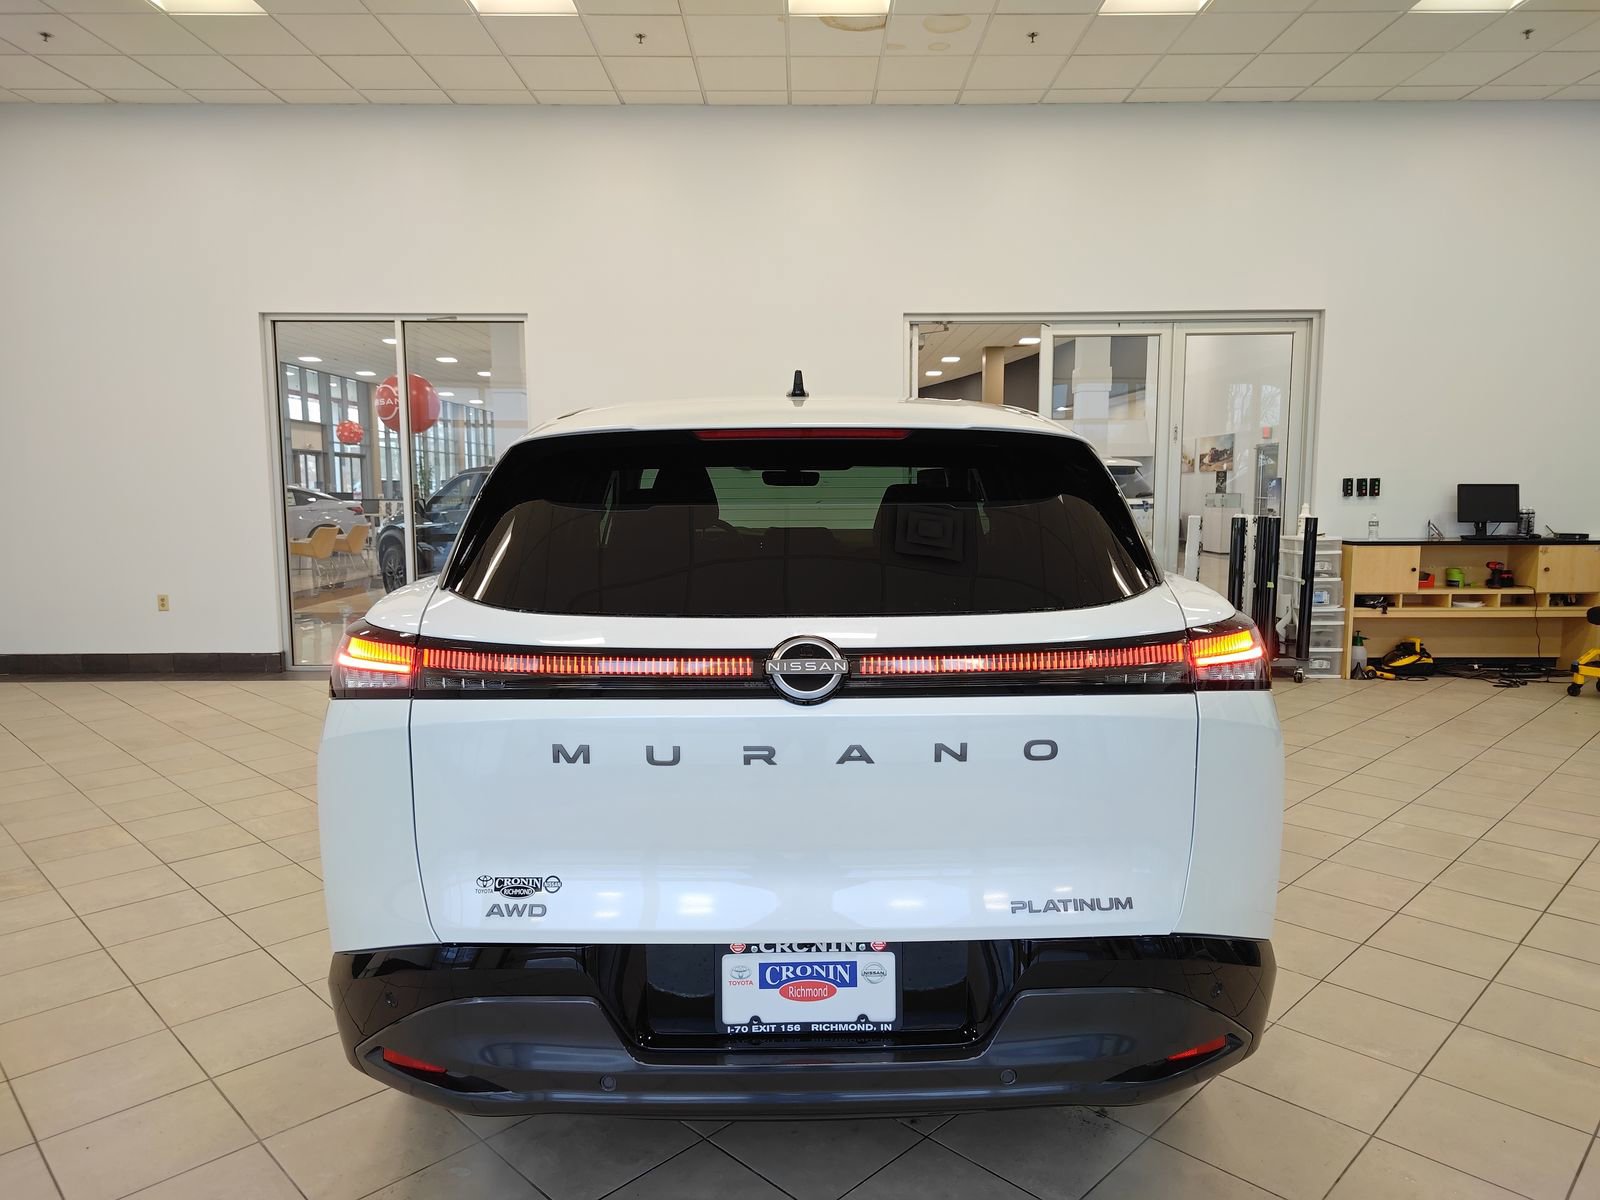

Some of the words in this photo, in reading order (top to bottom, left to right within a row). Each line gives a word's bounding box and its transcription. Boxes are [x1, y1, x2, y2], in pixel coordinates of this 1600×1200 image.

[768, 662, 846, 671] NISSAN
[552, 739, 1059, 767] MURANO
[495, 878, 542, 889] CRONIN
[485, 903, 547, 918] AWD
[1010, 896, 1134, 914] PLATINUM
[765, 964, 850, 984] CRONIN
[728, 979, 754, 987] TOYOTA
[788, 986, 828, 998] Richmond
[727, 1025, 748, 1034] I-70
[752, 1024, 777, 1033] EXIT
[781, 1024, 801, 1032] 156
[811, 1023, 877, 1032] RICHMOND,
[880, 1023, 893, 1031] IN
